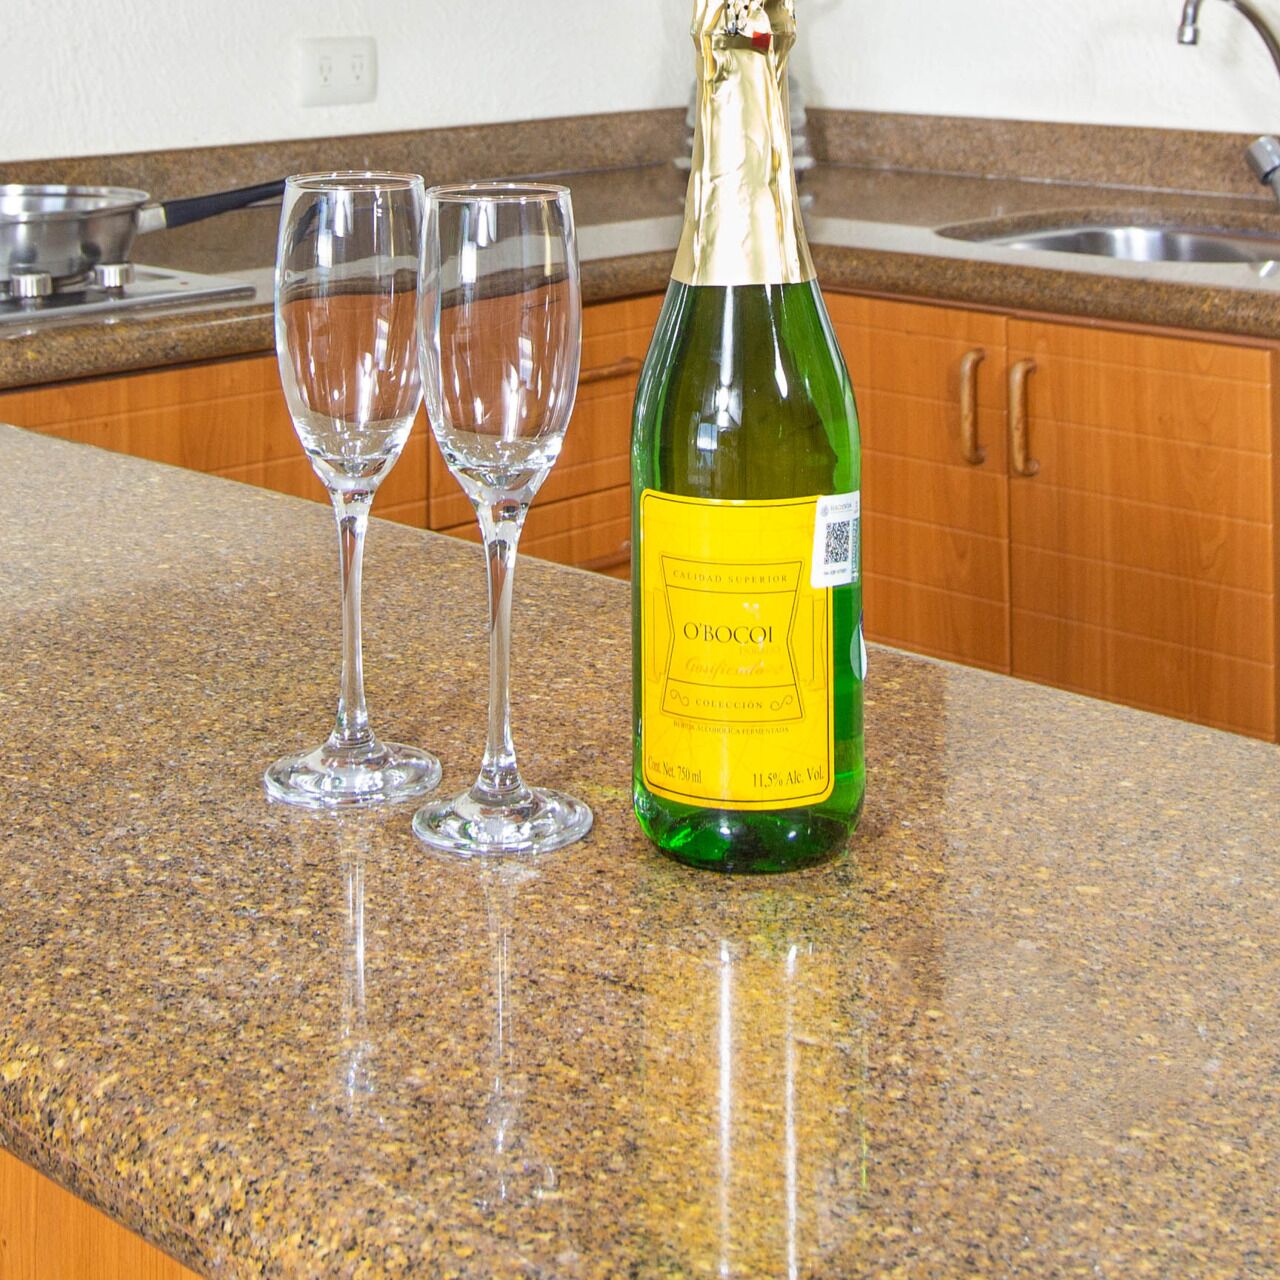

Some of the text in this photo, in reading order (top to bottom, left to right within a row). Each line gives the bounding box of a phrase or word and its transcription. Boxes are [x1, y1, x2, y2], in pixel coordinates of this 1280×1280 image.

[672, 569, 787, 584] CALIDAD SUPERIOR
[677, 765, 691, 782] 750
[785, 769, 804, 785] Alc.
[806, 764, 825, 782] Vol.
